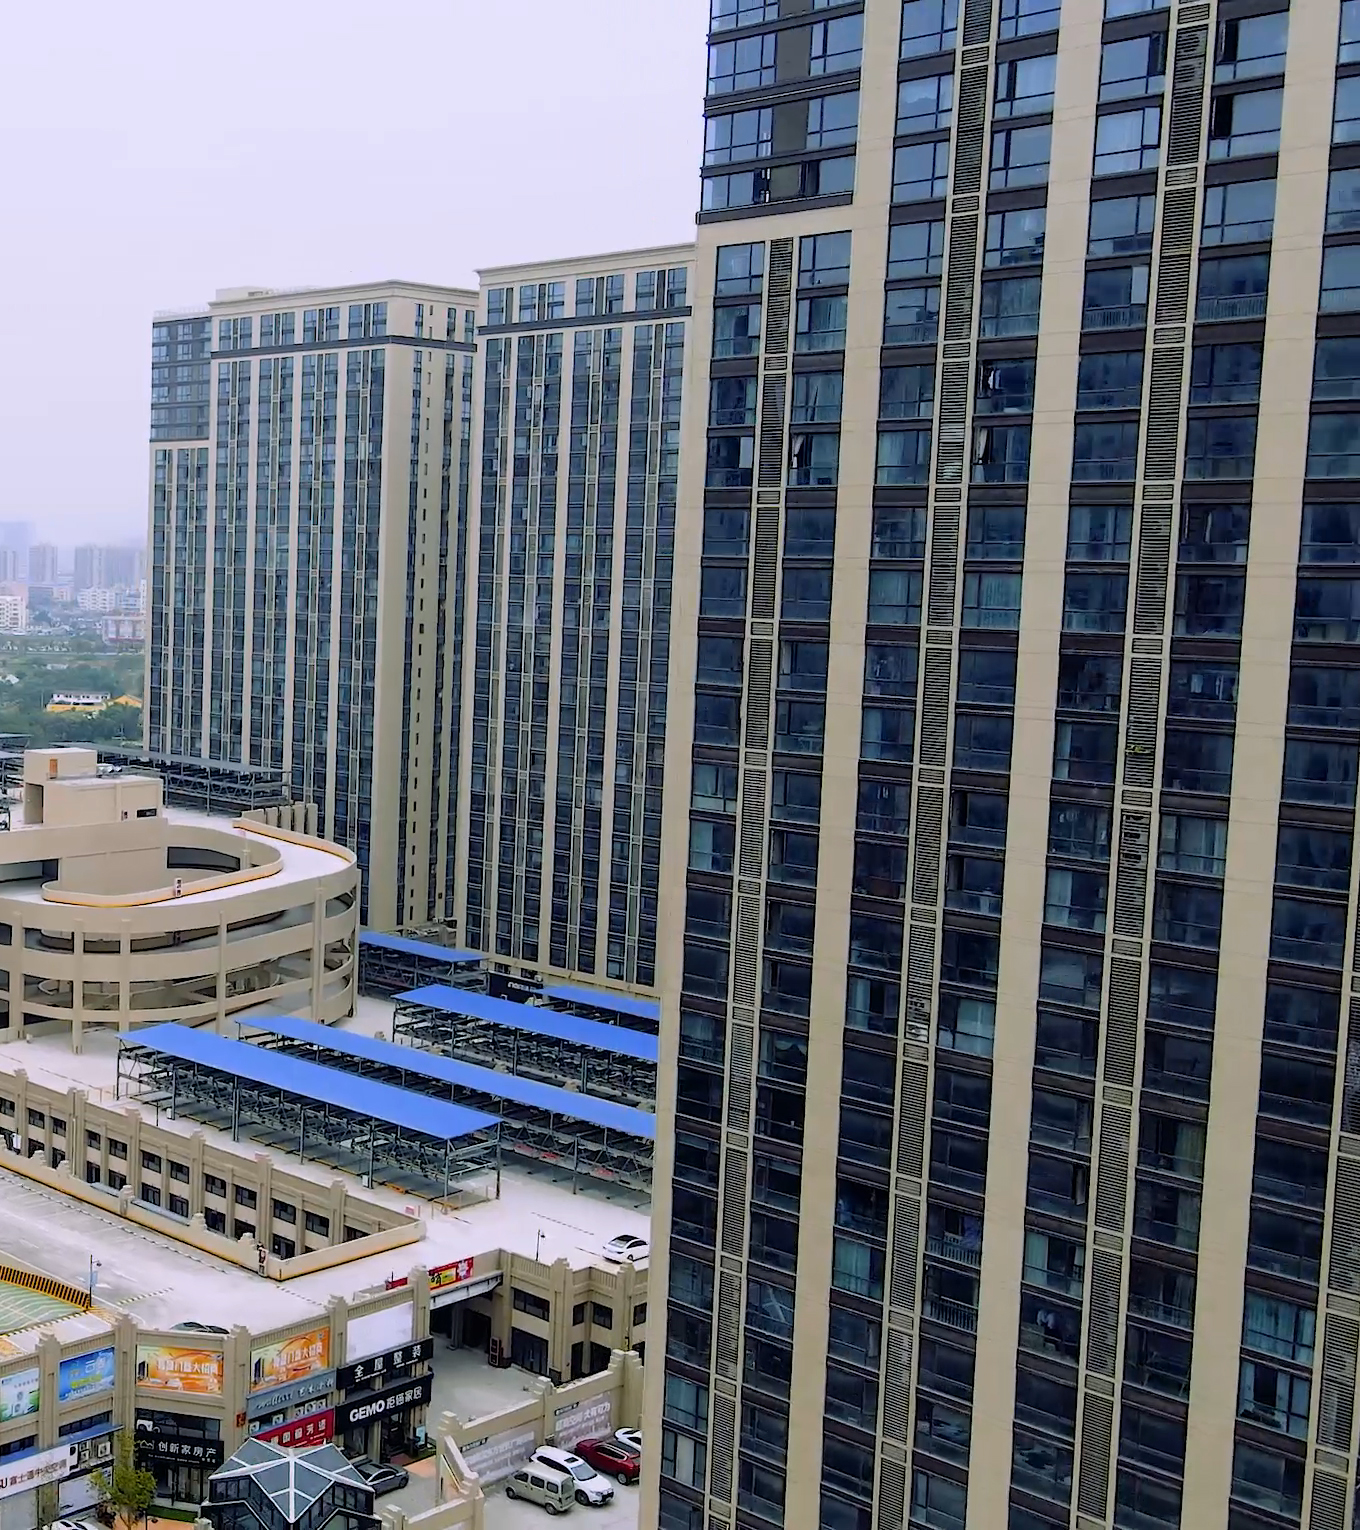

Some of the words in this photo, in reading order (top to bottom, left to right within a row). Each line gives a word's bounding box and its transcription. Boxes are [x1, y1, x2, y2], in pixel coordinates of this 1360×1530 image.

[349, 1400, 385, 1423] GEMO
[158, 1441, 218, 1457] 创新家房产
